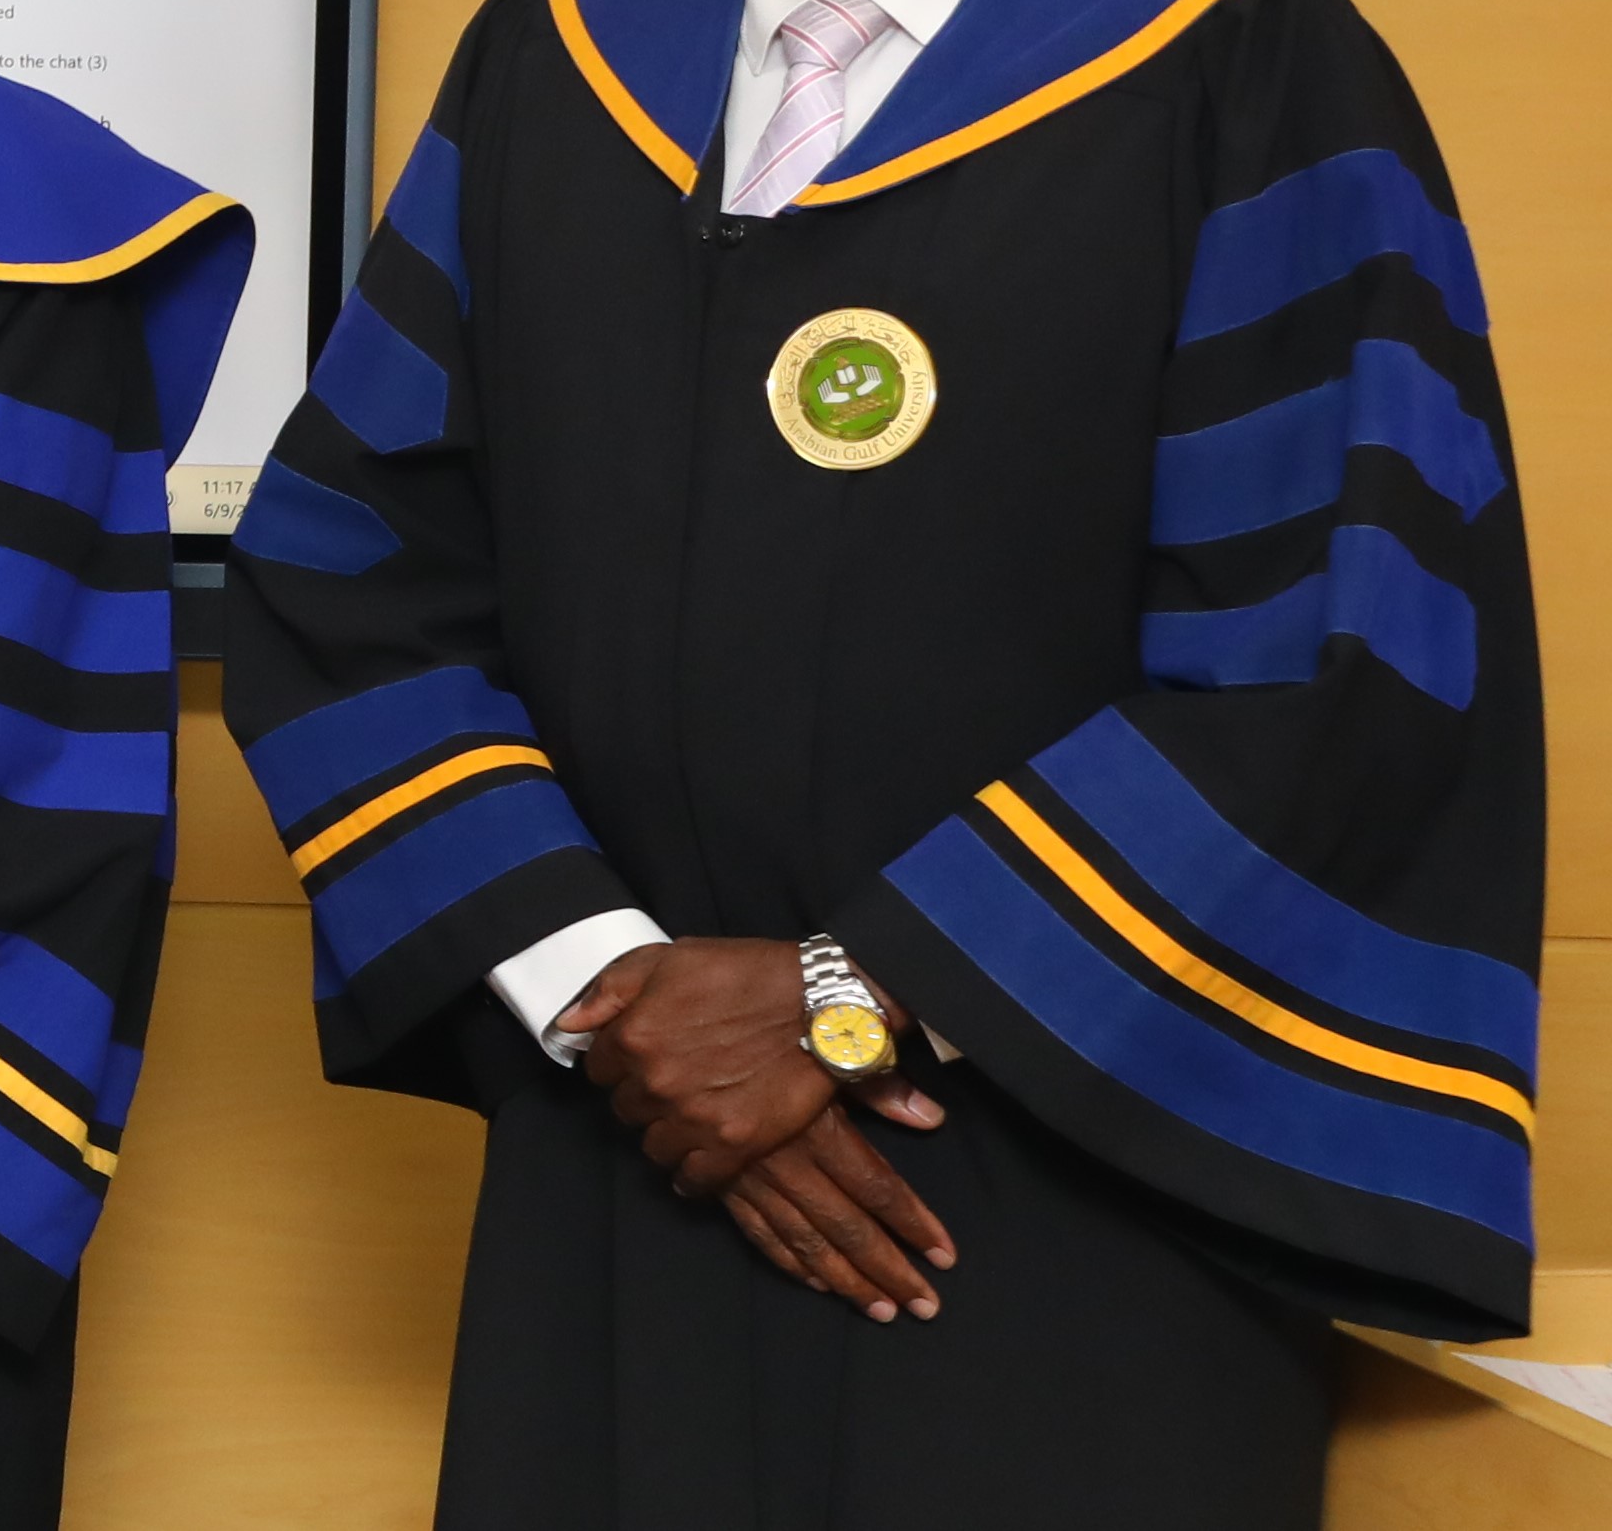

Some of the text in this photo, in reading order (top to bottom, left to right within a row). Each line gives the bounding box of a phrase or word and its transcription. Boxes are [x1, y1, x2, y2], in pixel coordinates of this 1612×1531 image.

[0, 55, 14, 68] to
[20, 54, 44, 68] the
[49, 54, 83, 69] chat
[87, 55, 108, 71] (3)
[784, 371, 927, 461] Arabian Gulf University
[203, 480, 243, 494] 11:17
